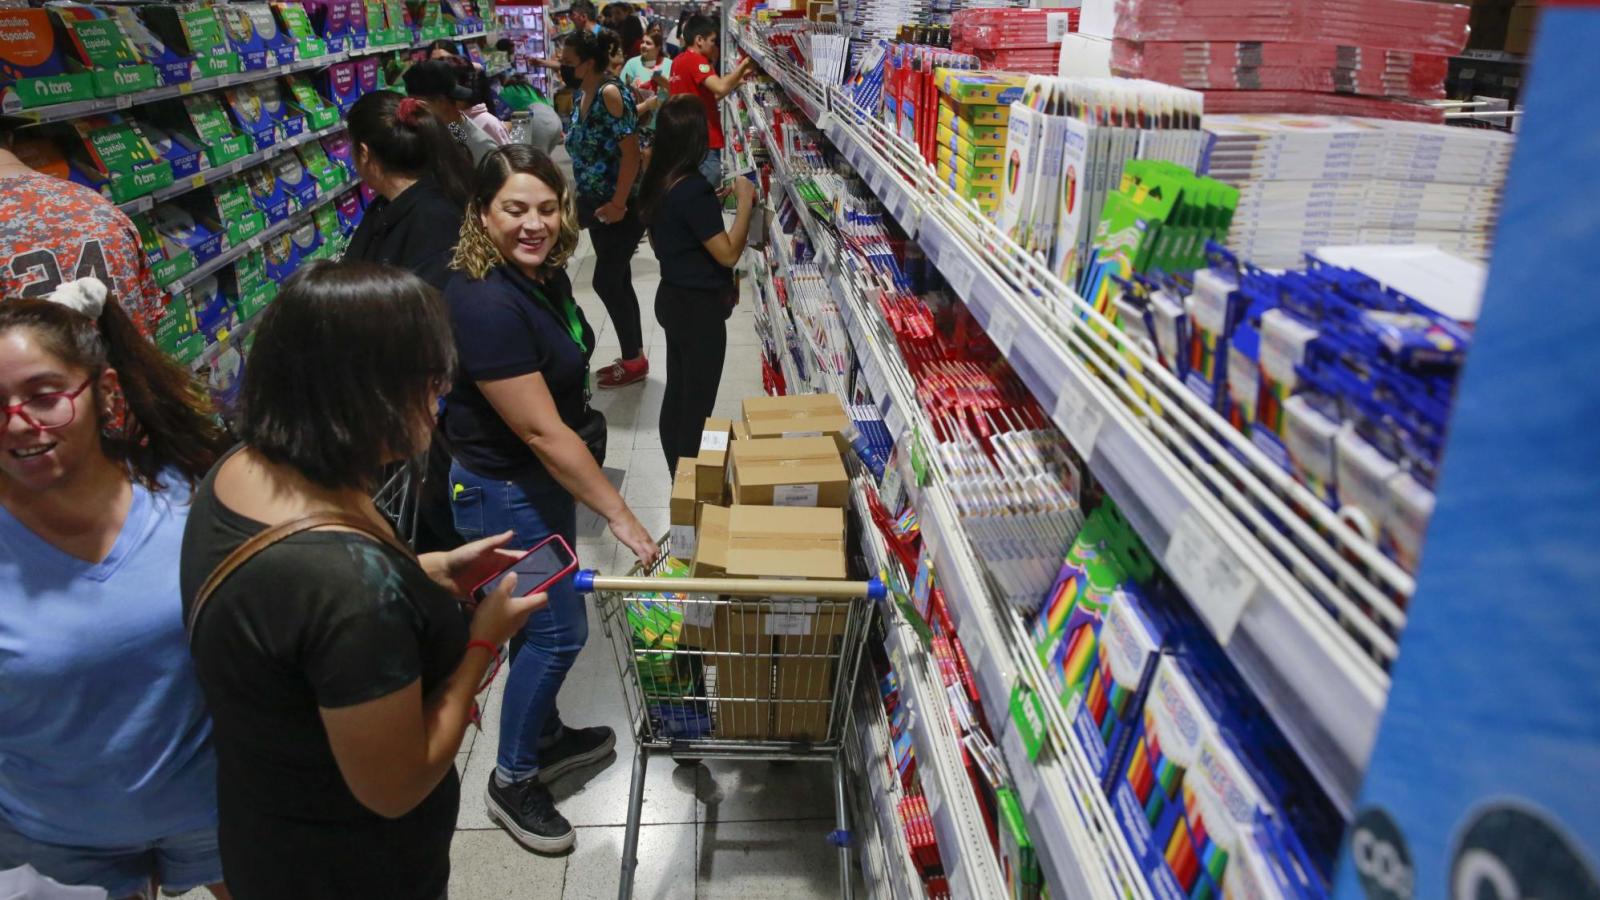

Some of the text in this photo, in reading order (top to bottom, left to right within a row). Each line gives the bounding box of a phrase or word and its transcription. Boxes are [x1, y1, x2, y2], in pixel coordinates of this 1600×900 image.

[48, 81, 73, 94] torre
[98, 142, 127, 157] Española
[9, 238, 118, 299] 24
